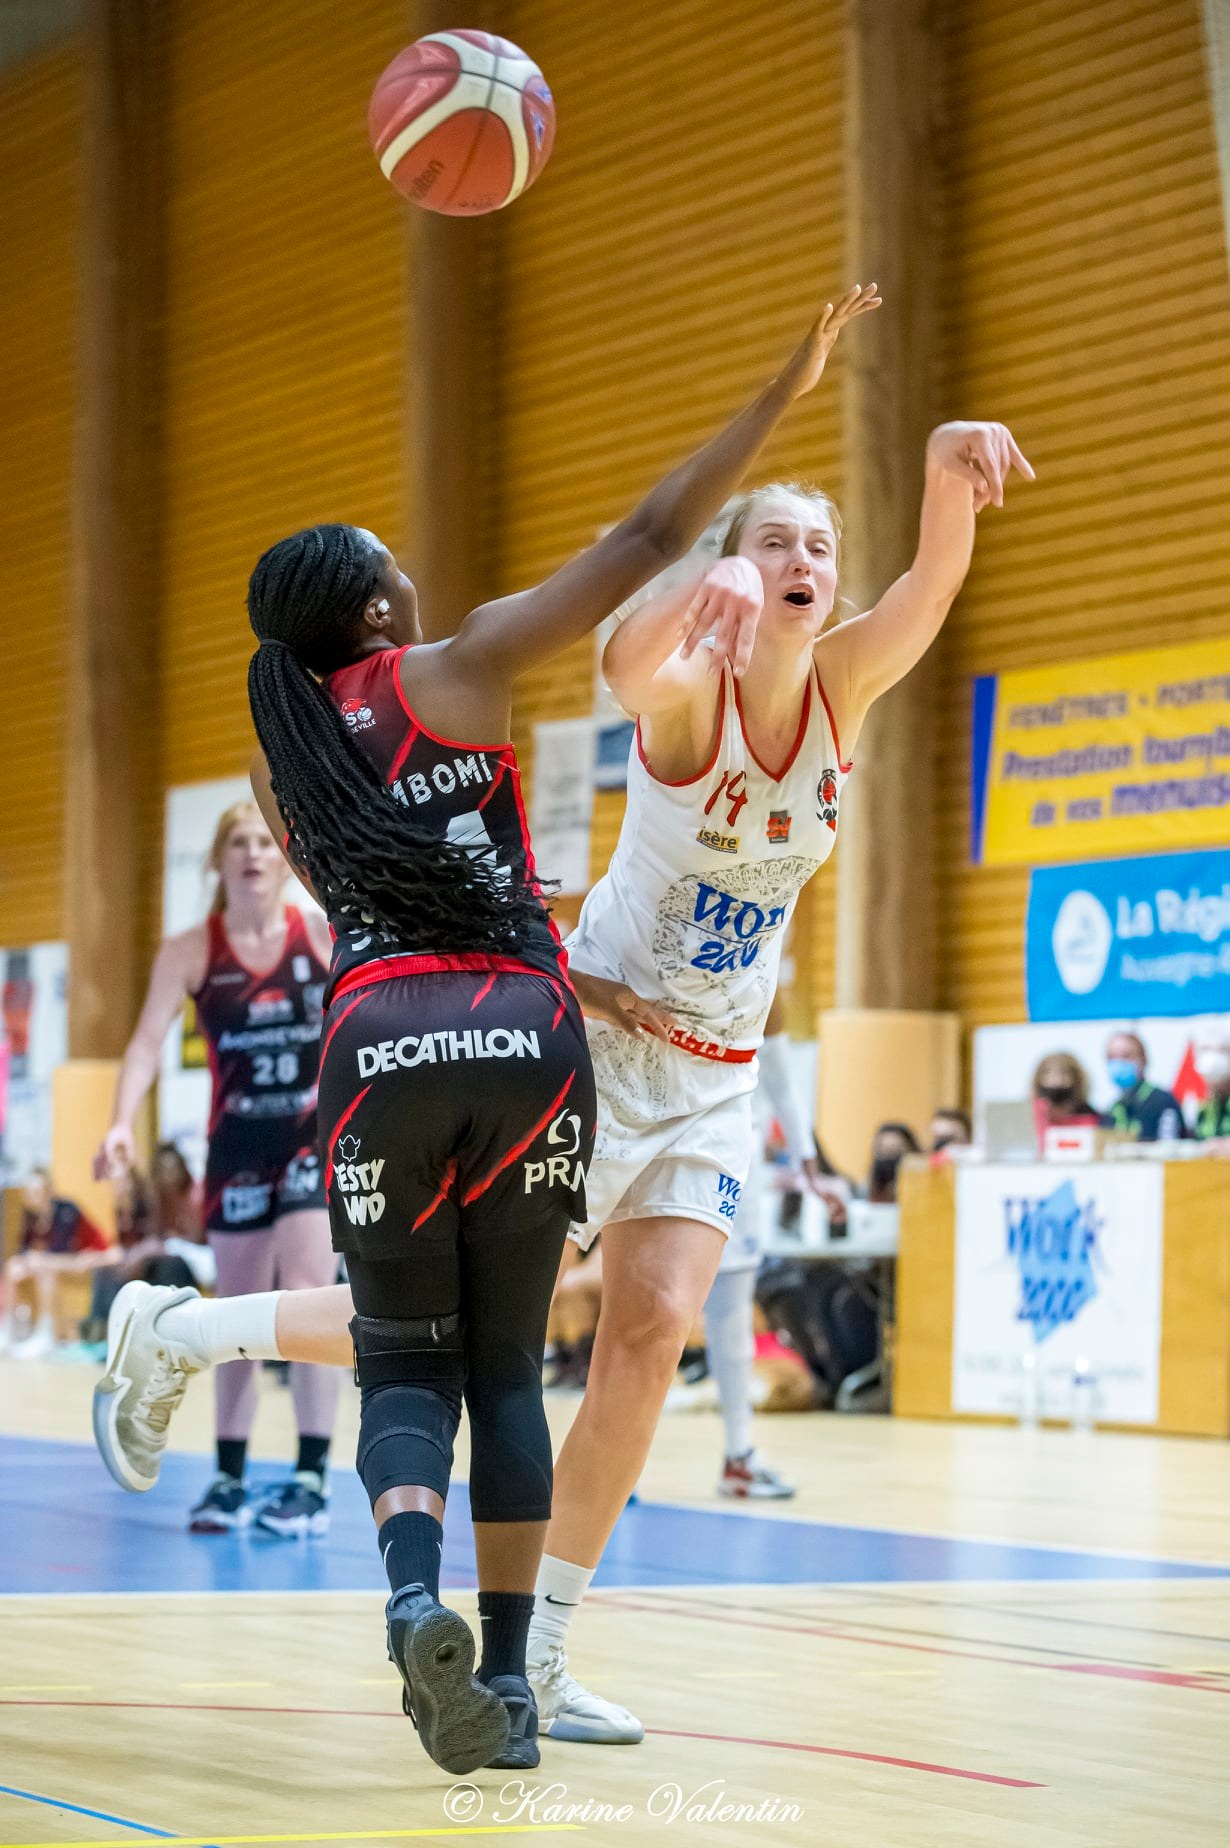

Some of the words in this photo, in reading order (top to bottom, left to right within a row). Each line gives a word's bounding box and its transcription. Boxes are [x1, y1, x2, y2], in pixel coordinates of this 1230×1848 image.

[704, 770, 748, 828] 14
[1115, 894, 1154, 939] La
[356, 1028, 541, 1079] DECATHLON
[333, 1158, 386, 1192] ESTY
